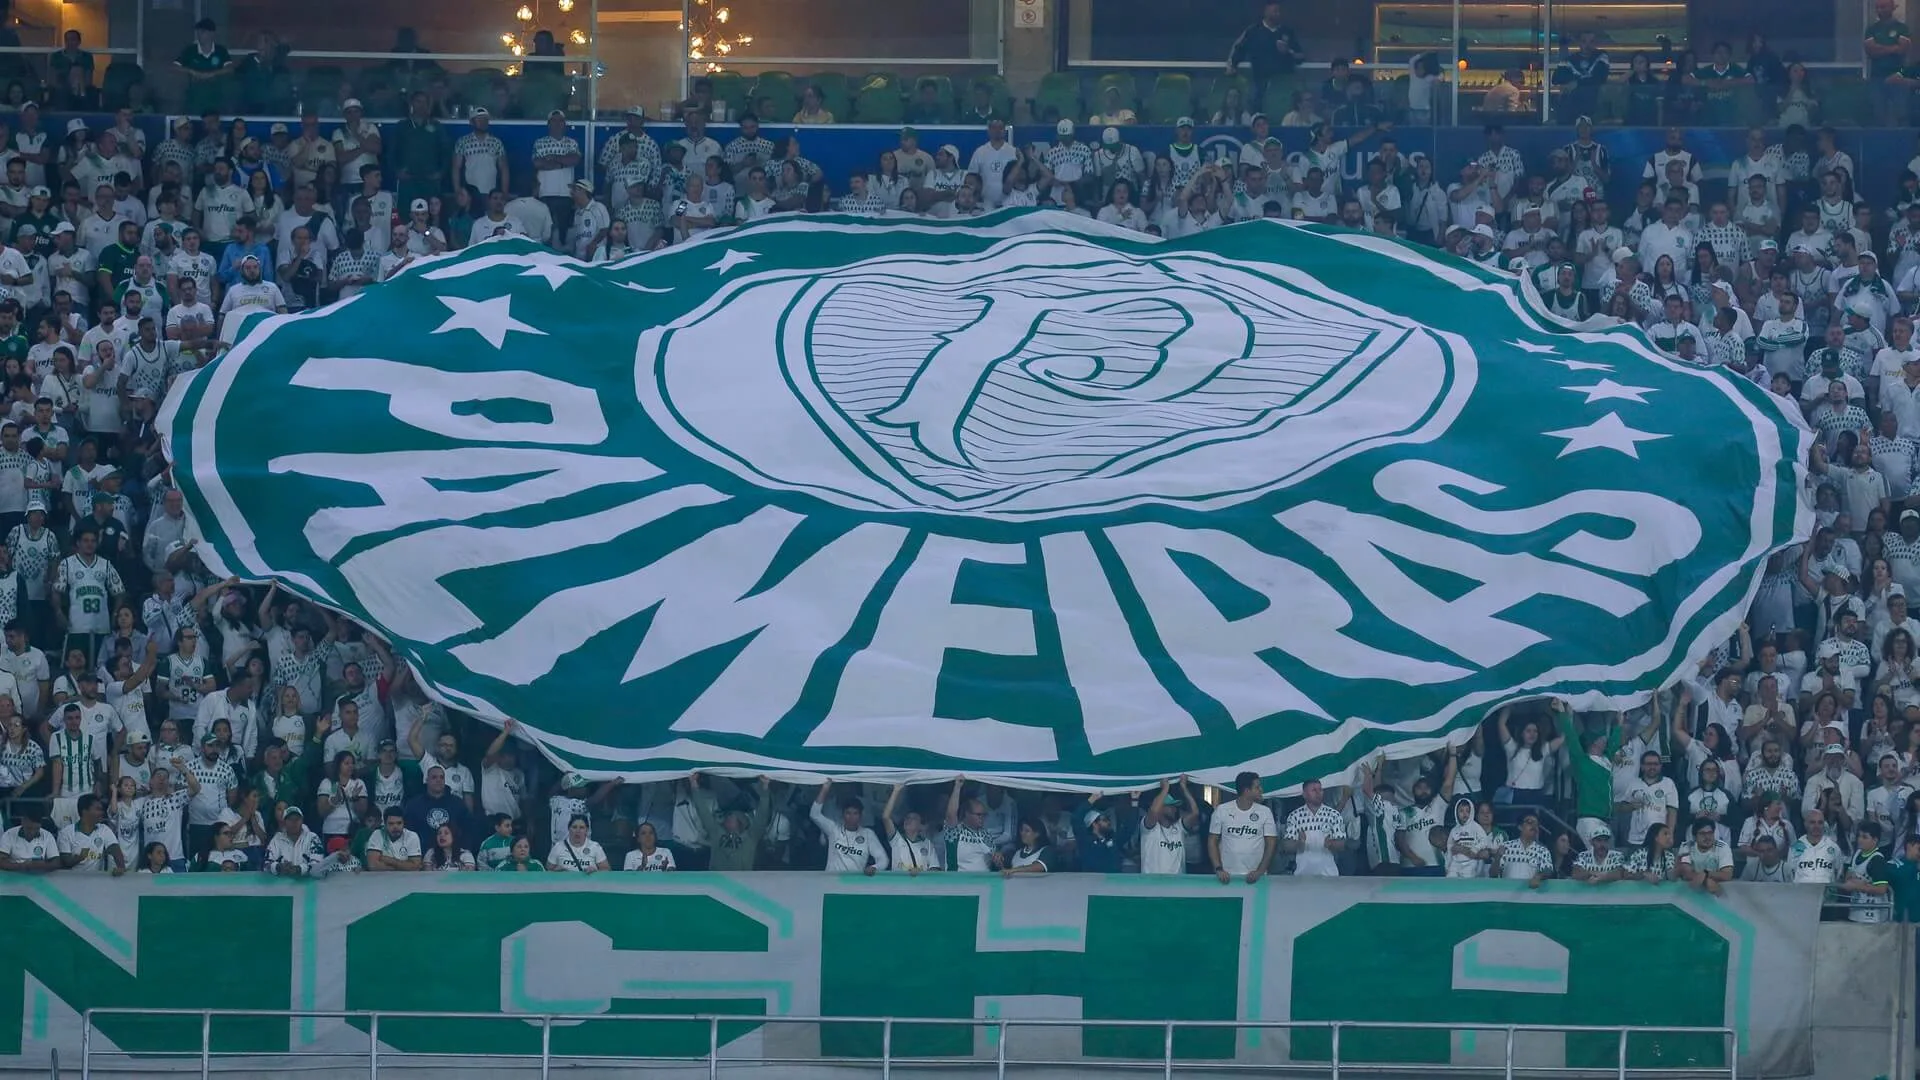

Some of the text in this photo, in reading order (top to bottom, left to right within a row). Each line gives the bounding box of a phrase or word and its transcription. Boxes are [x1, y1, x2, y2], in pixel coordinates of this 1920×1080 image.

[267, 356, 1702, 762] PALMEIRAS
[83, 598, 101, 614] 83
[1227, 825, 1258, 836] crefisa
[1407, 817, 1434, 833] crefisa
[835, 843, 863, 856] crefisa
[1799, 858, 1833, 870] crefisa
